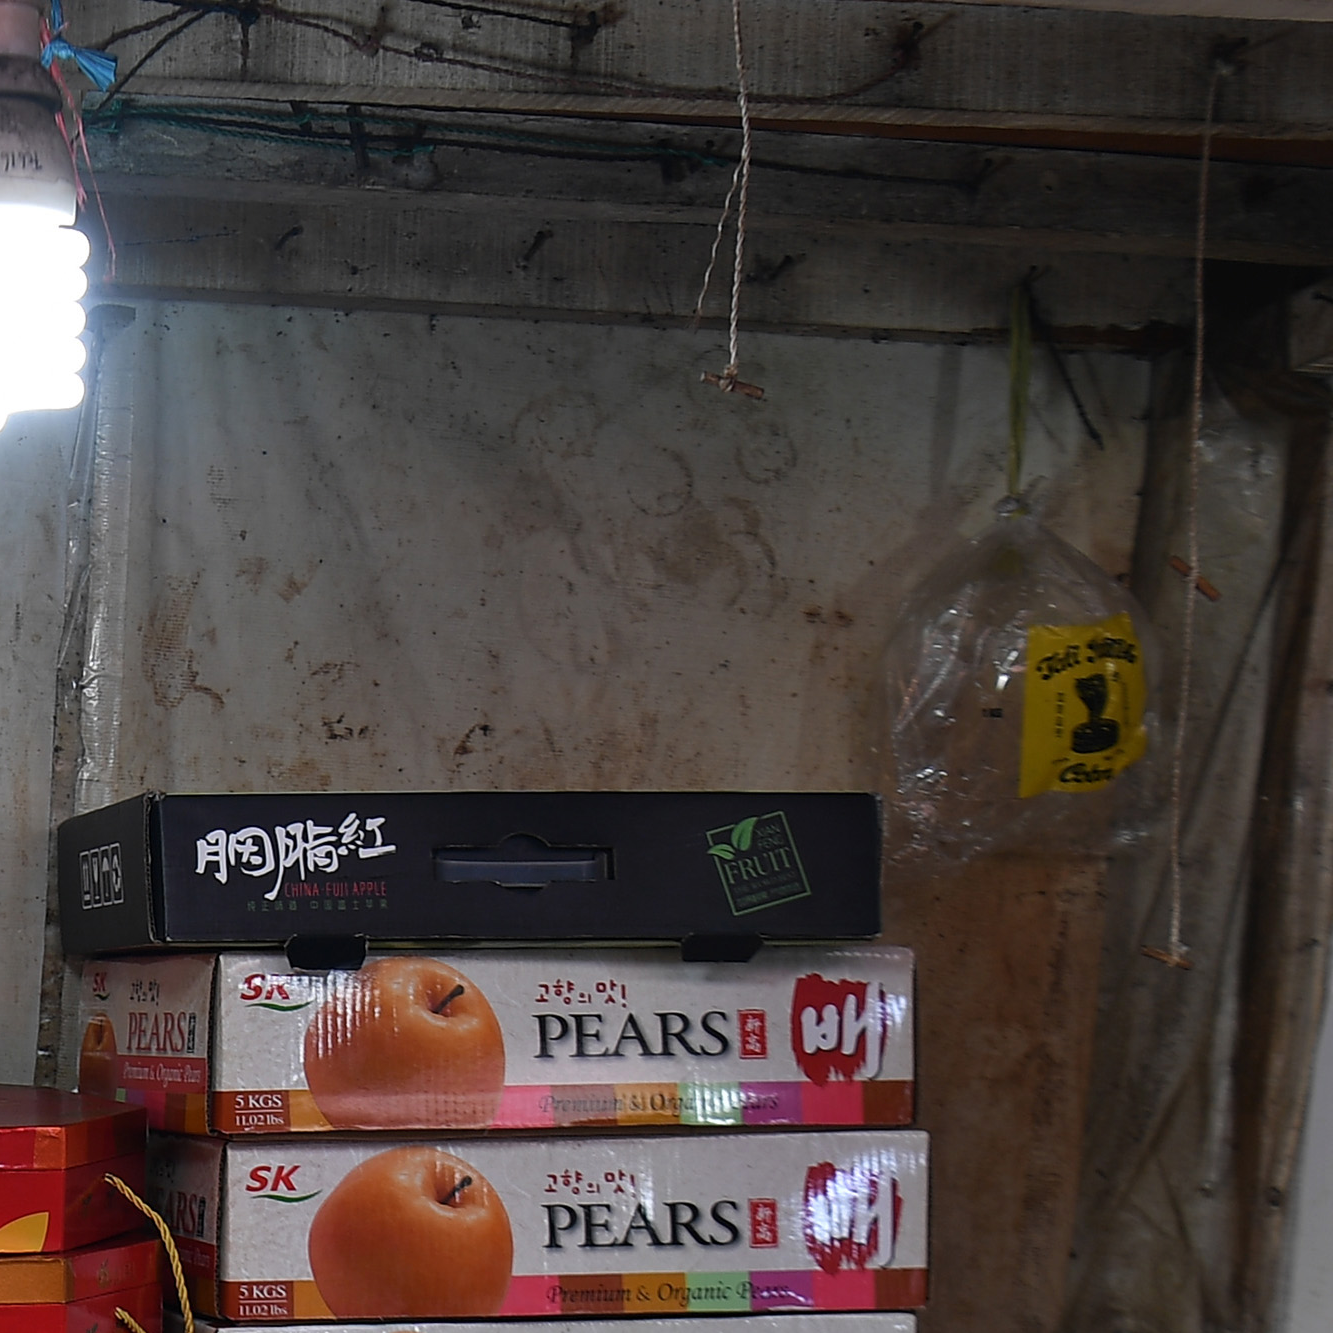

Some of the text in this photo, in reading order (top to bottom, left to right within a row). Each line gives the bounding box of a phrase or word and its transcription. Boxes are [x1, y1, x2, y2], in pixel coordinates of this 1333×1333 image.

[724, 846, 791, 885] FRUIT
[352, 881, 387, 897] APPLE
[535, 979, 592, 1005] 고향의
[126, 1010, 187, 1053] PEARS
[532, 1009, 731, 1060] PEARS
[234, 1094, 283, 1109] 5 KGS
[235, 1113, 285, 1127] 11.02 lbs
[244, 1164, 302, 1192] SK
[544, 1170, 602, 1197] 고향의
[542, 1200, 742, 1251] PEARS
[238, 1284, 287, 1299] 5 KGS
[546, 1280, 793, 1307] Premium & Organic Pears
[238, 1304, 289, 1317] 11.02 lbs
